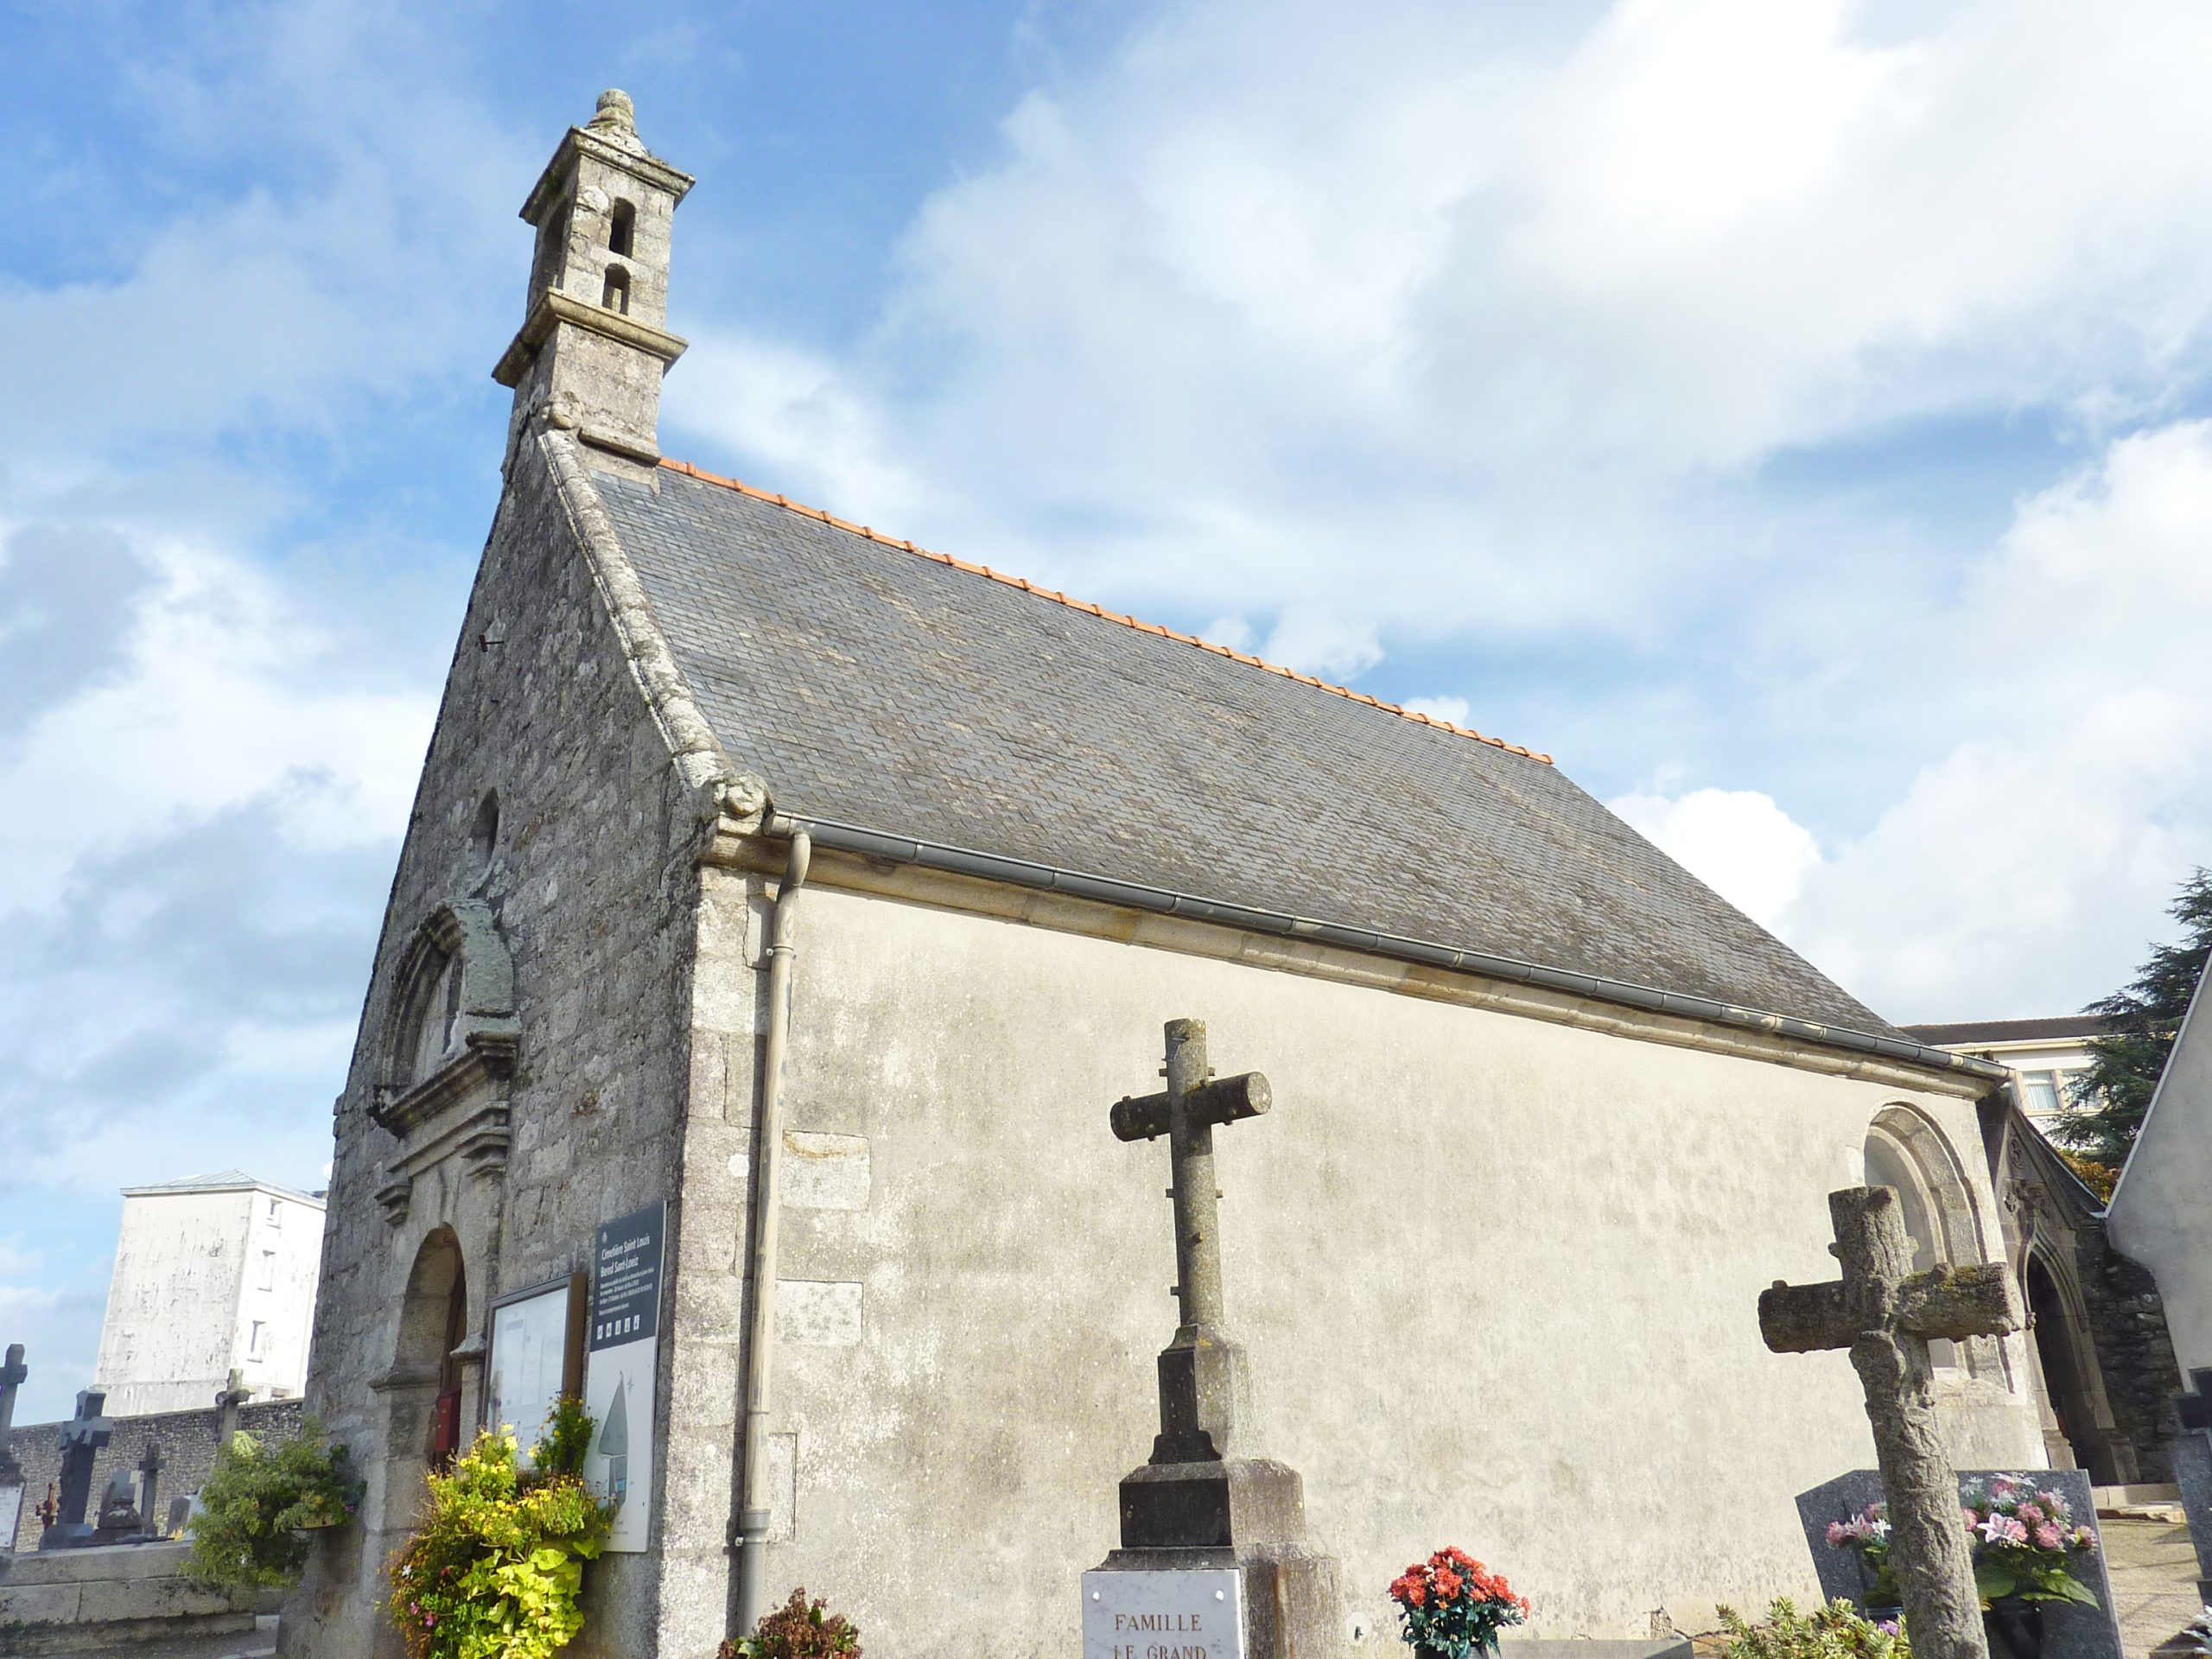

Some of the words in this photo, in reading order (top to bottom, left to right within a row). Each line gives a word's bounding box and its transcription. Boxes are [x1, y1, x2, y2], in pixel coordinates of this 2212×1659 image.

[601, 1243, 623, 1260] Cimetière
[624, 1238, 636, 1253] Saint
[637, 1233, 651, 1249] Louis
[1115, 1613, 1202, 1631] FAMILLE
[1147, 1644, 1207, 1659] GRAND
